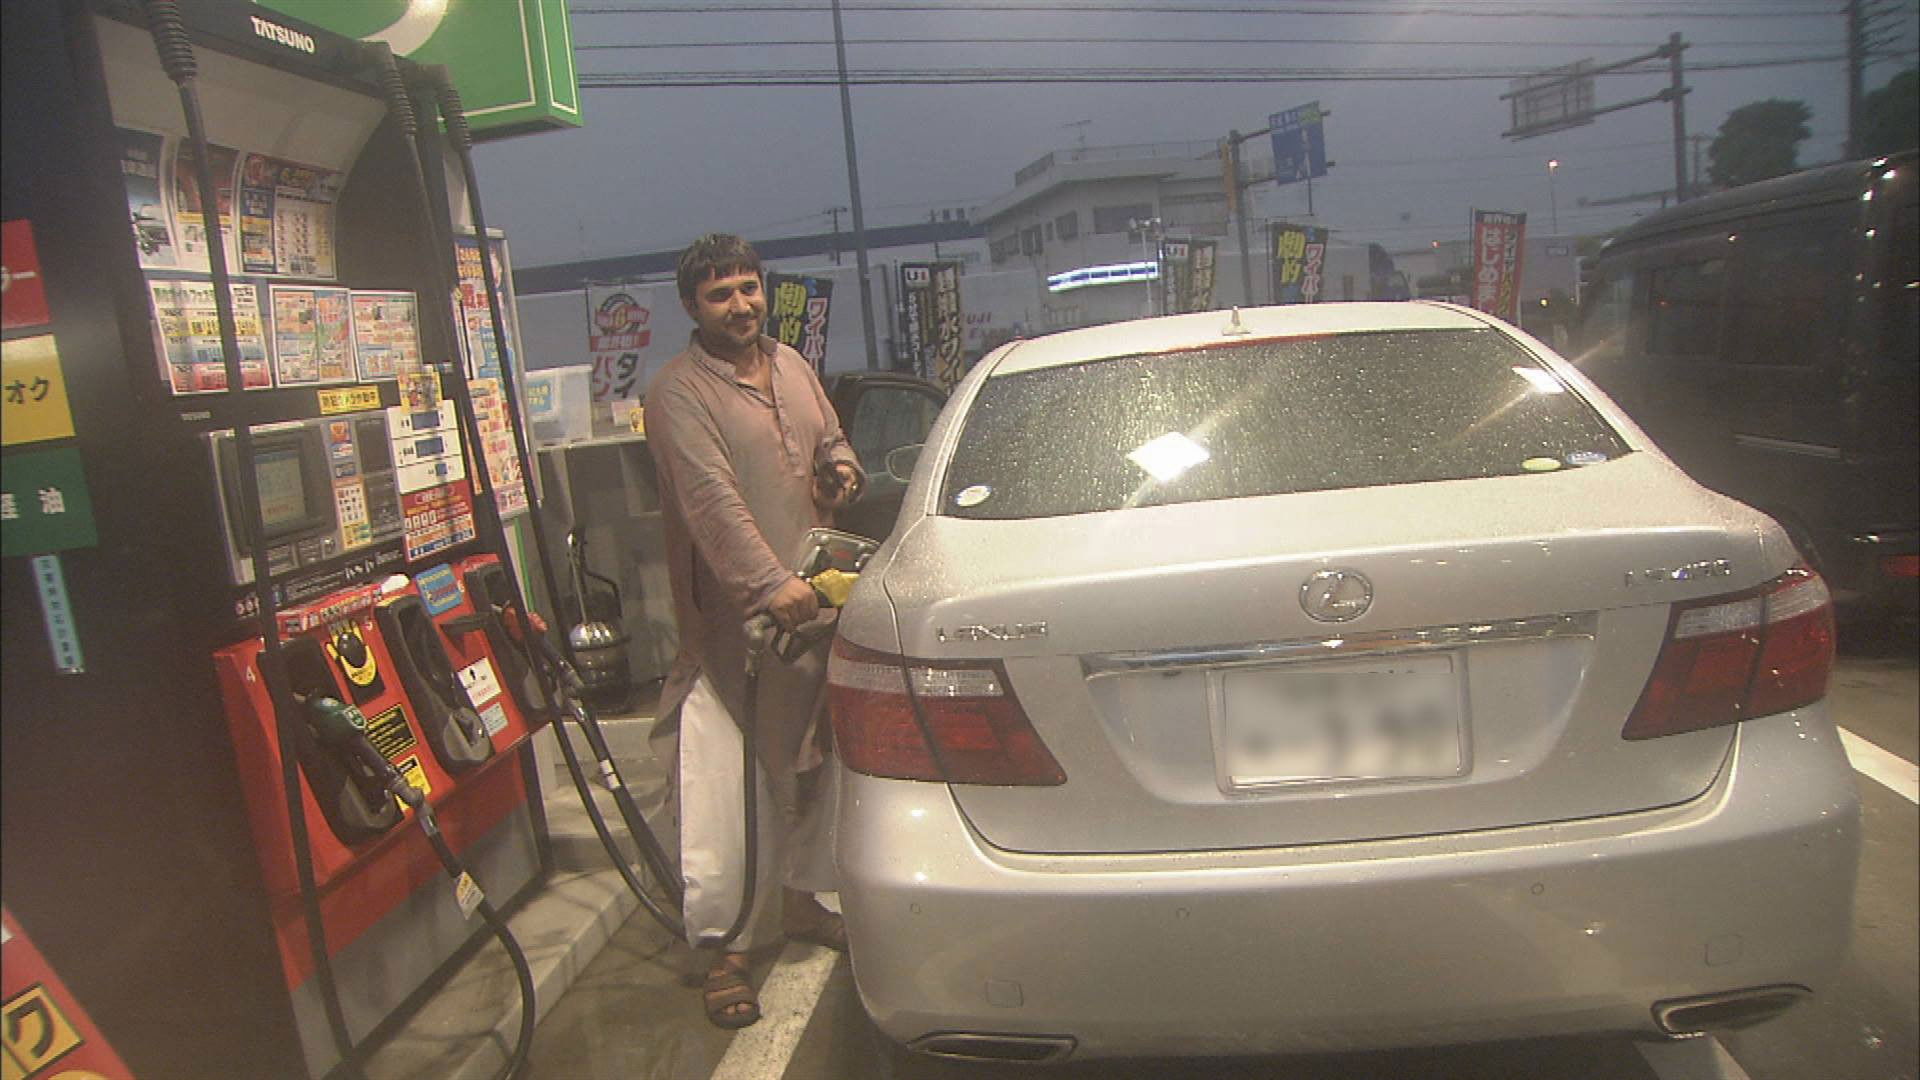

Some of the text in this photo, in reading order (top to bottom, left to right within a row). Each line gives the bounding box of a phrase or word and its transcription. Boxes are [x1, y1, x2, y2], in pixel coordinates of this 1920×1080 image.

[250, 15, 316, 54] TATSUNO
[1477, 225, 1501, 314] はじめま
